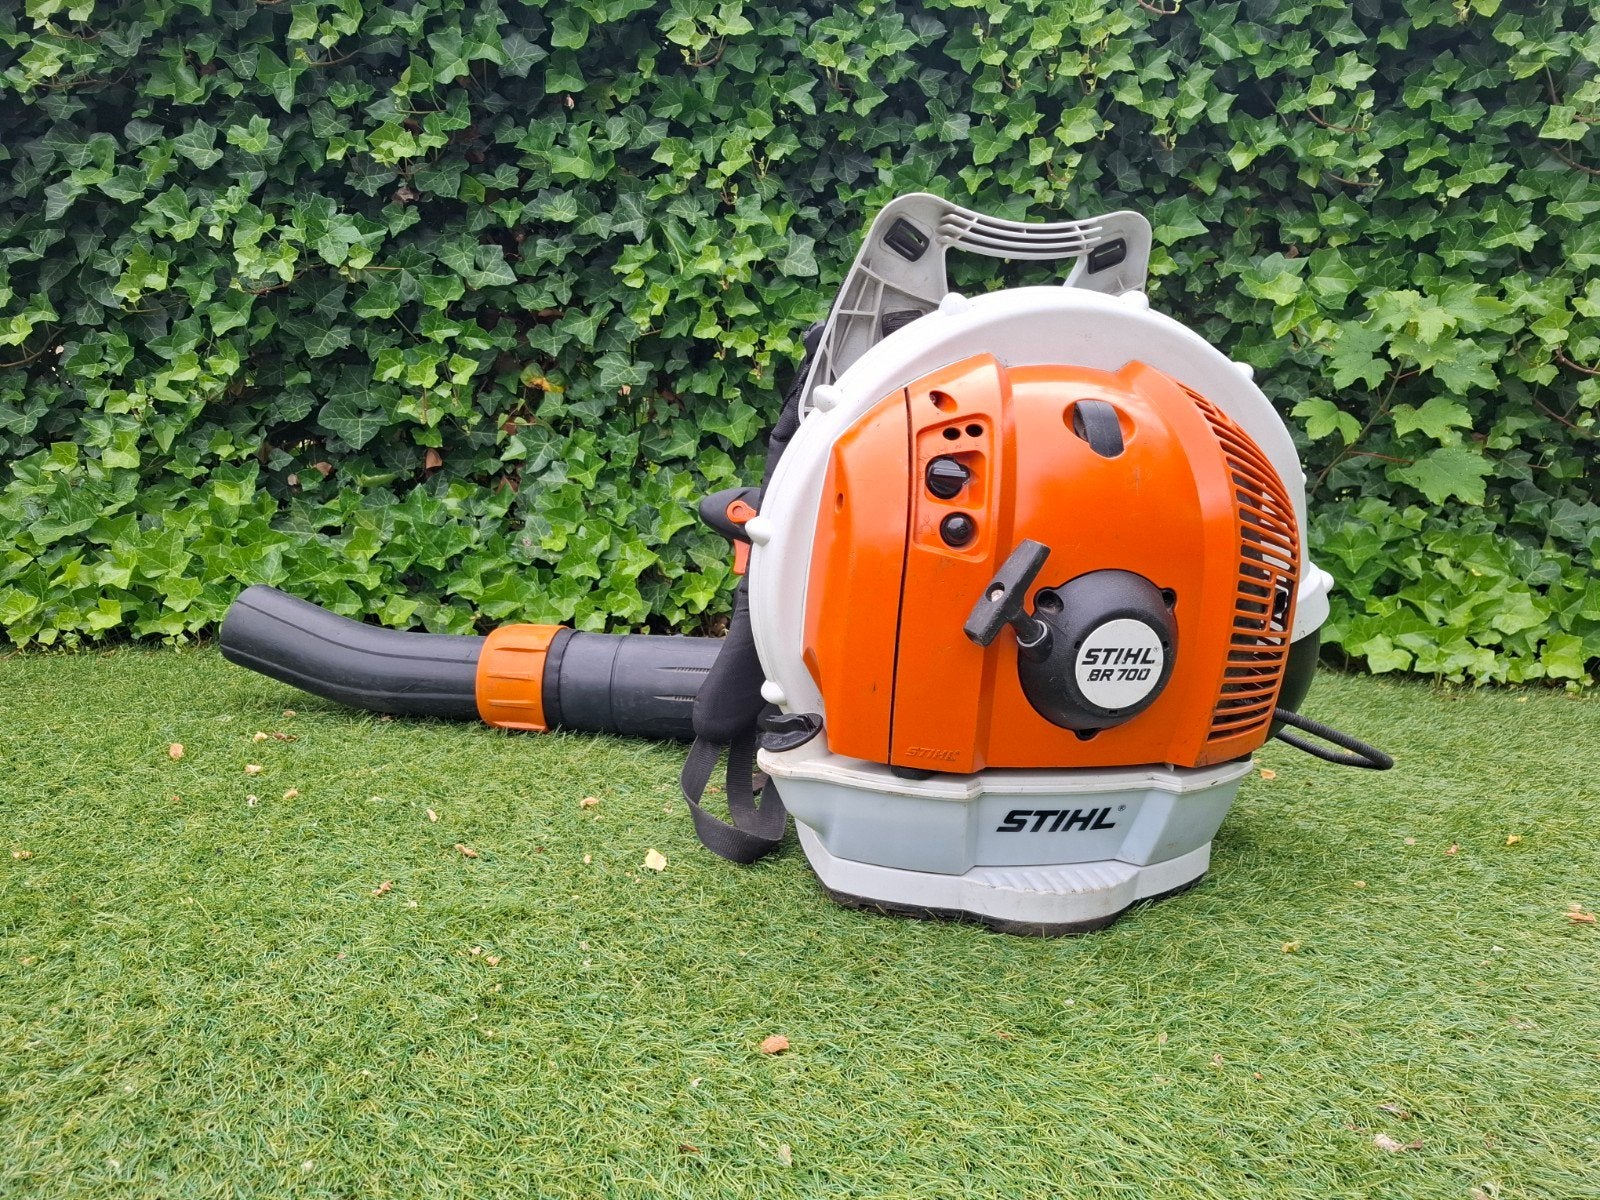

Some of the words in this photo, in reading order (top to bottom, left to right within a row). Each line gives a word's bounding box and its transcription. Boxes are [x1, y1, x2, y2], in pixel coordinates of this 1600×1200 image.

[1081, 648, 1155, 665] STIHL
[1087, 669, 1114, 681] BR
[1117, 668, 1151, 681] 700
[996, 807, 1116, 832] STIHL
